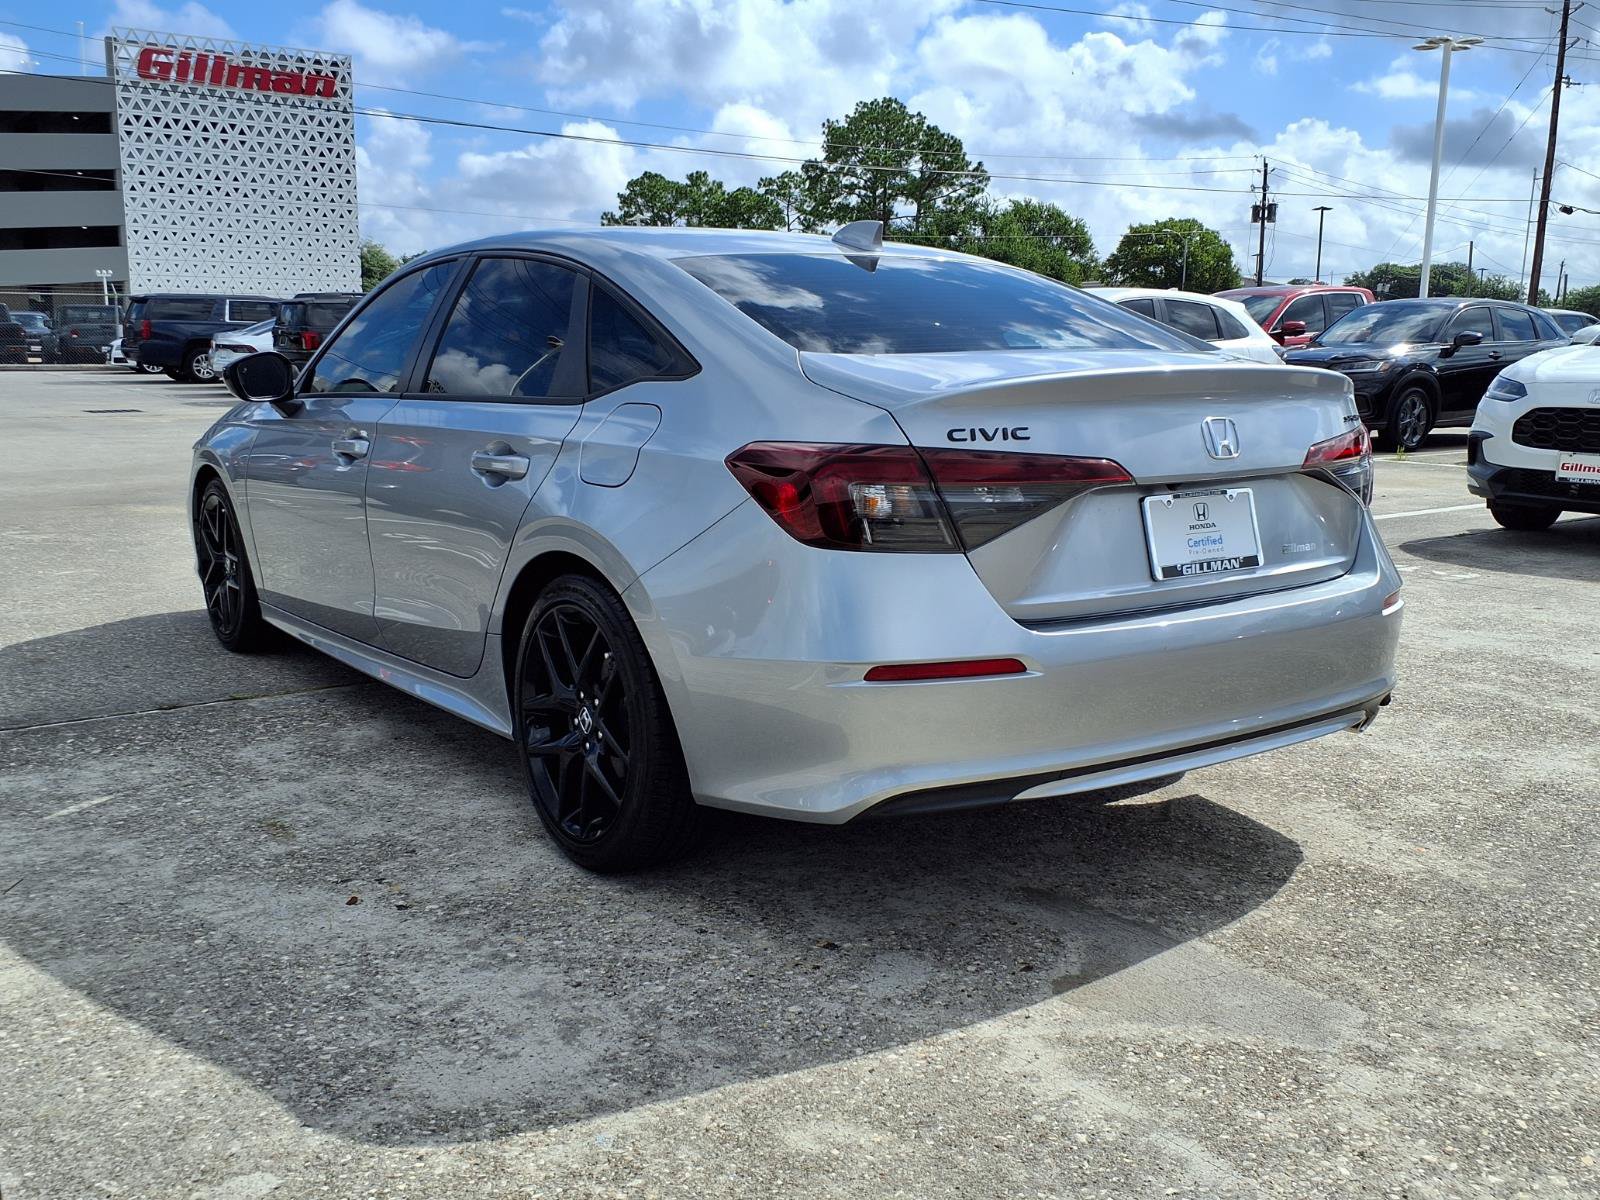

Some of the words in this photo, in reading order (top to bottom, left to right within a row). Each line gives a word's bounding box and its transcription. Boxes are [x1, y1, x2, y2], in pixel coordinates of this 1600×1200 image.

[137, 48, 336, 99] Gillman
[947, 427, 1031, 441] CIVIC
[1189, 522, 1216, 530] HONDA
[1187, 534, 1223, 548] Certified
[1182, 558, 1240, 575] GILLMAN
